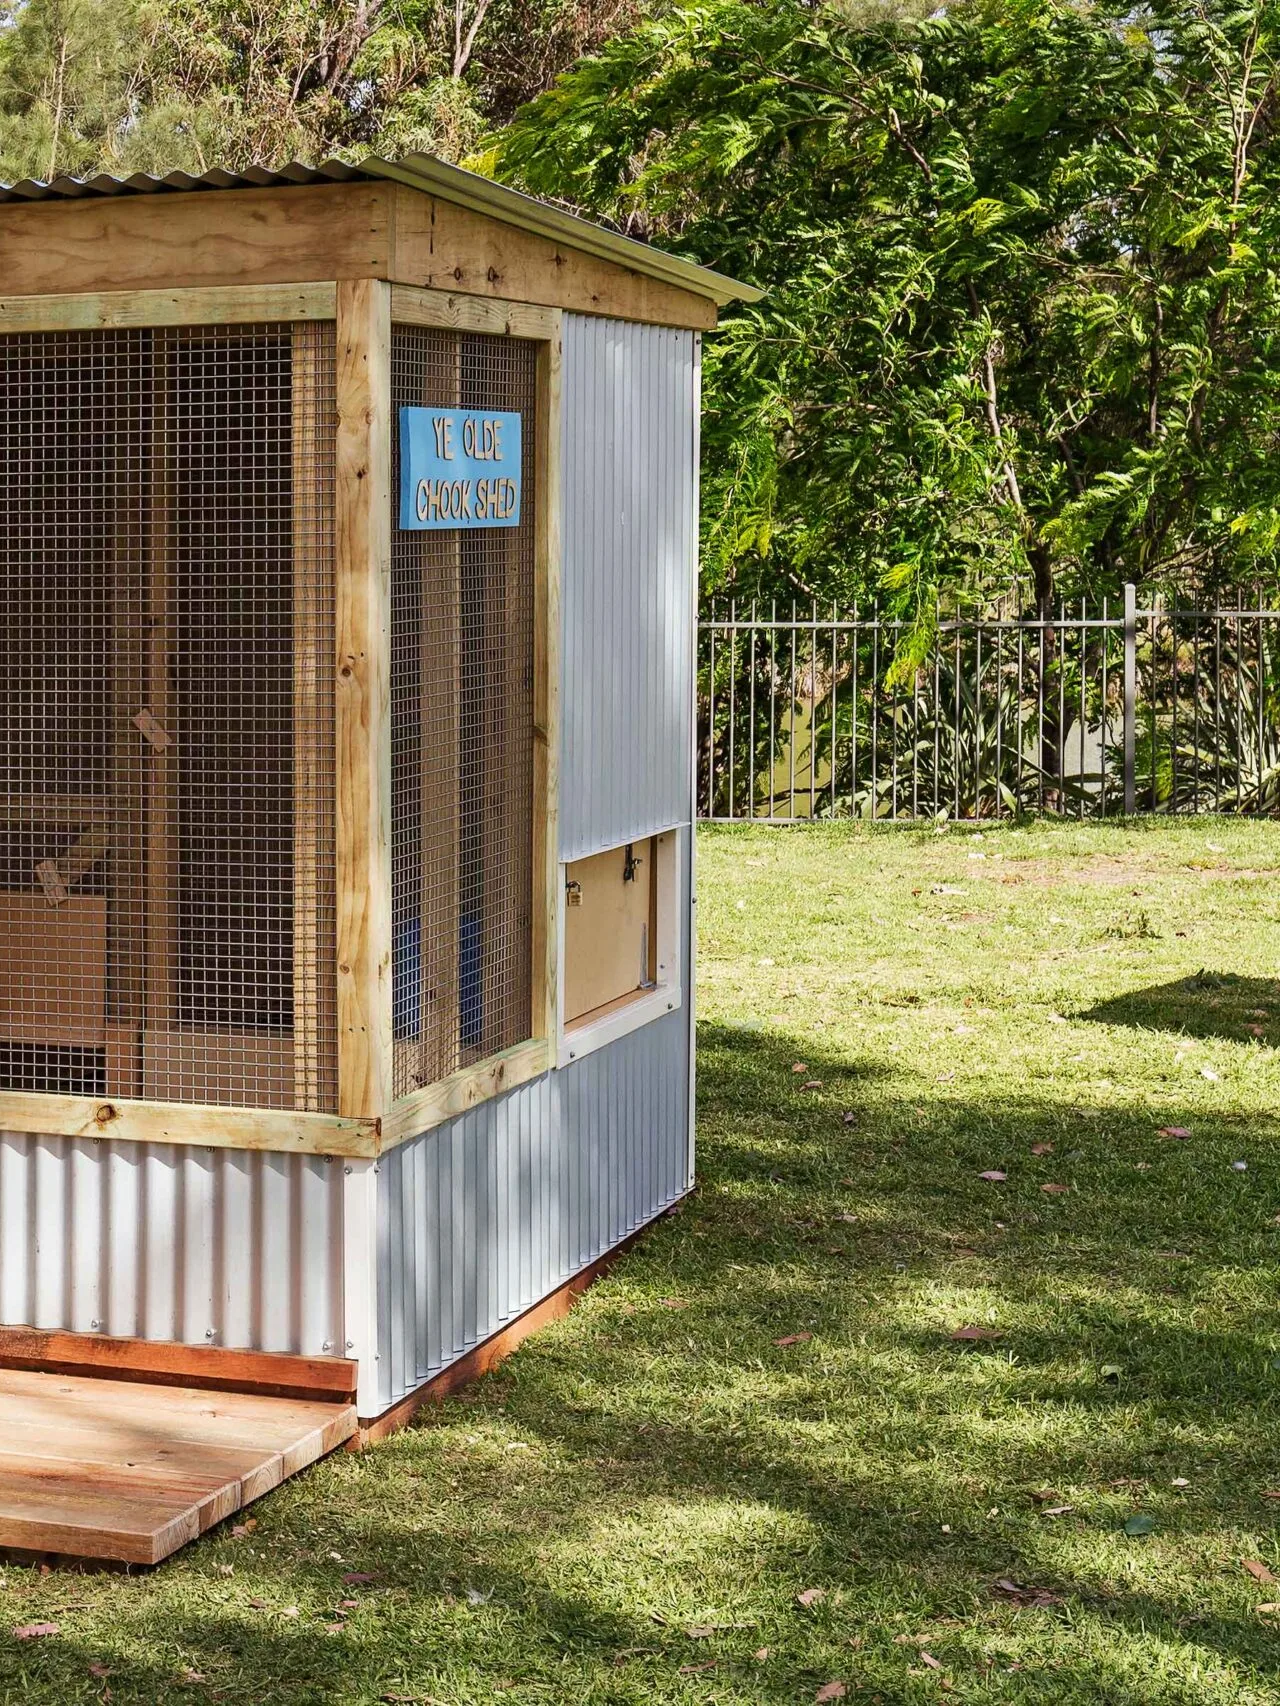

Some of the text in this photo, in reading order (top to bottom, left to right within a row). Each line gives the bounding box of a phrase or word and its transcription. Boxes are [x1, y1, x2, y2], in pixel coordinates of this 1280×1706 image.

[432, 417, 504, 461] YE OLDE
[416, 477, 517, 521] CHOOK SHED
